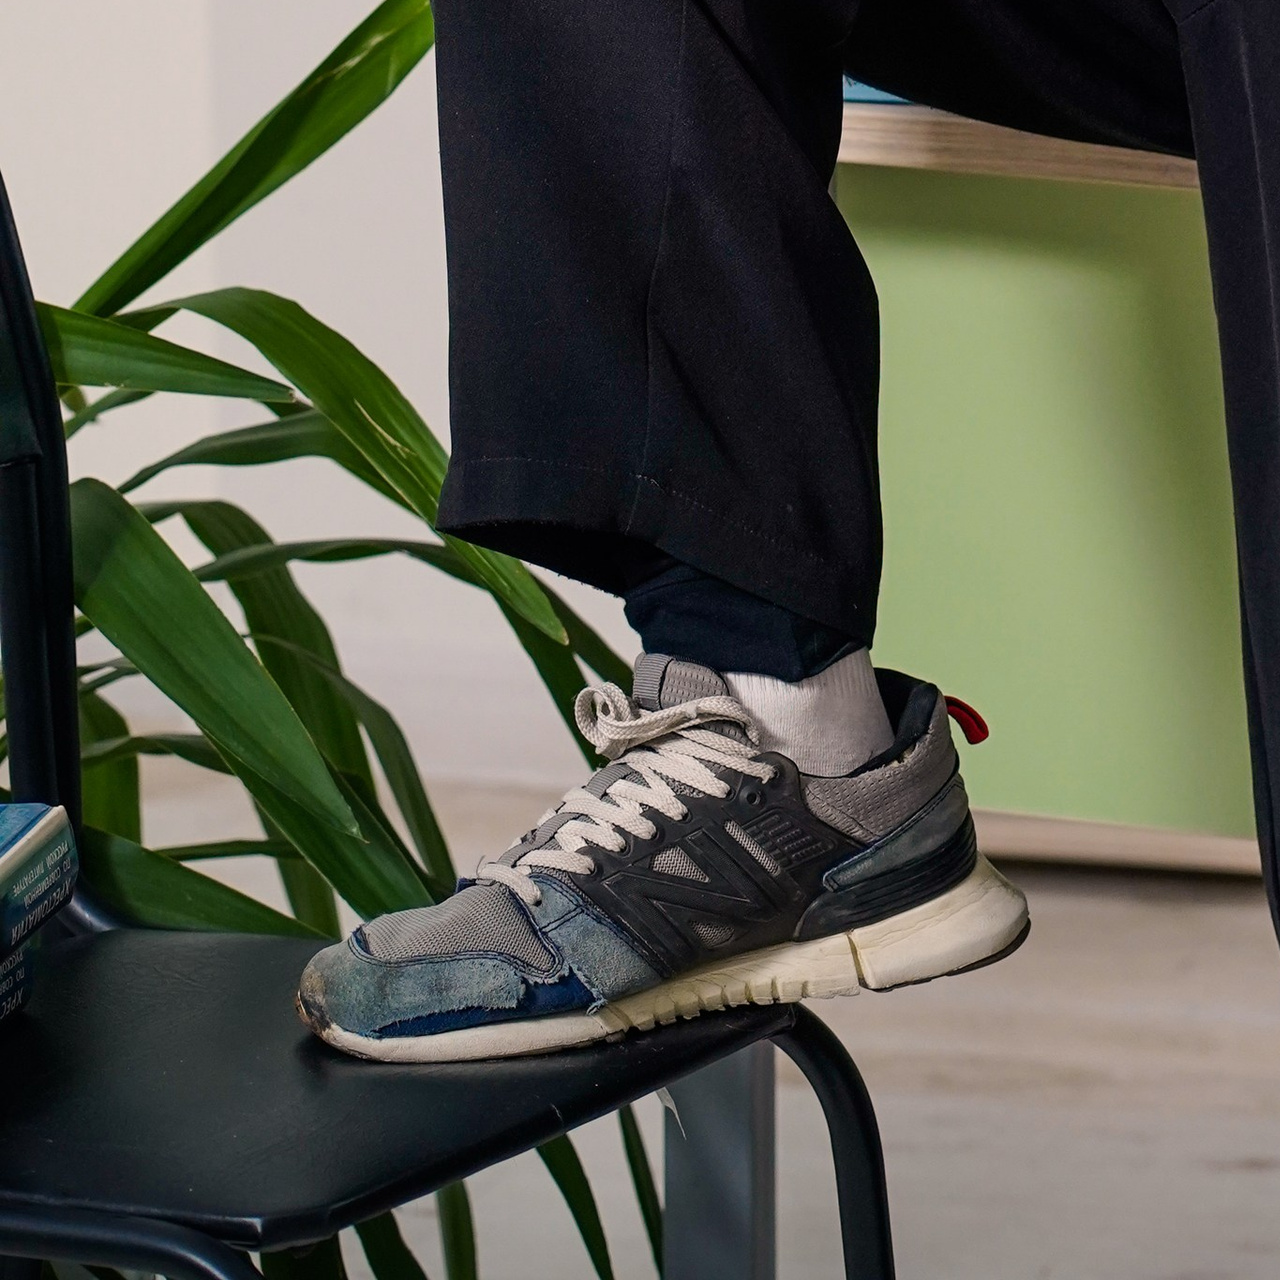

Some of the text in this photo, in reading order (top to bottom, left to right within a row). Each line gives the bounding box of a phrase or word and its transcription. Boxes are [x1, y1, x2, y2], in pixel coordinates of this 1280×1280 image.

[12, 840, 69, 897] РУССКОЙ ЛИТЕРАТУРЕ
[23, 856, 71, 909] ПО СОВРЕМЕННОЙ
[11, 878, 71, 946] ХРЕСТОМАТИЯ
